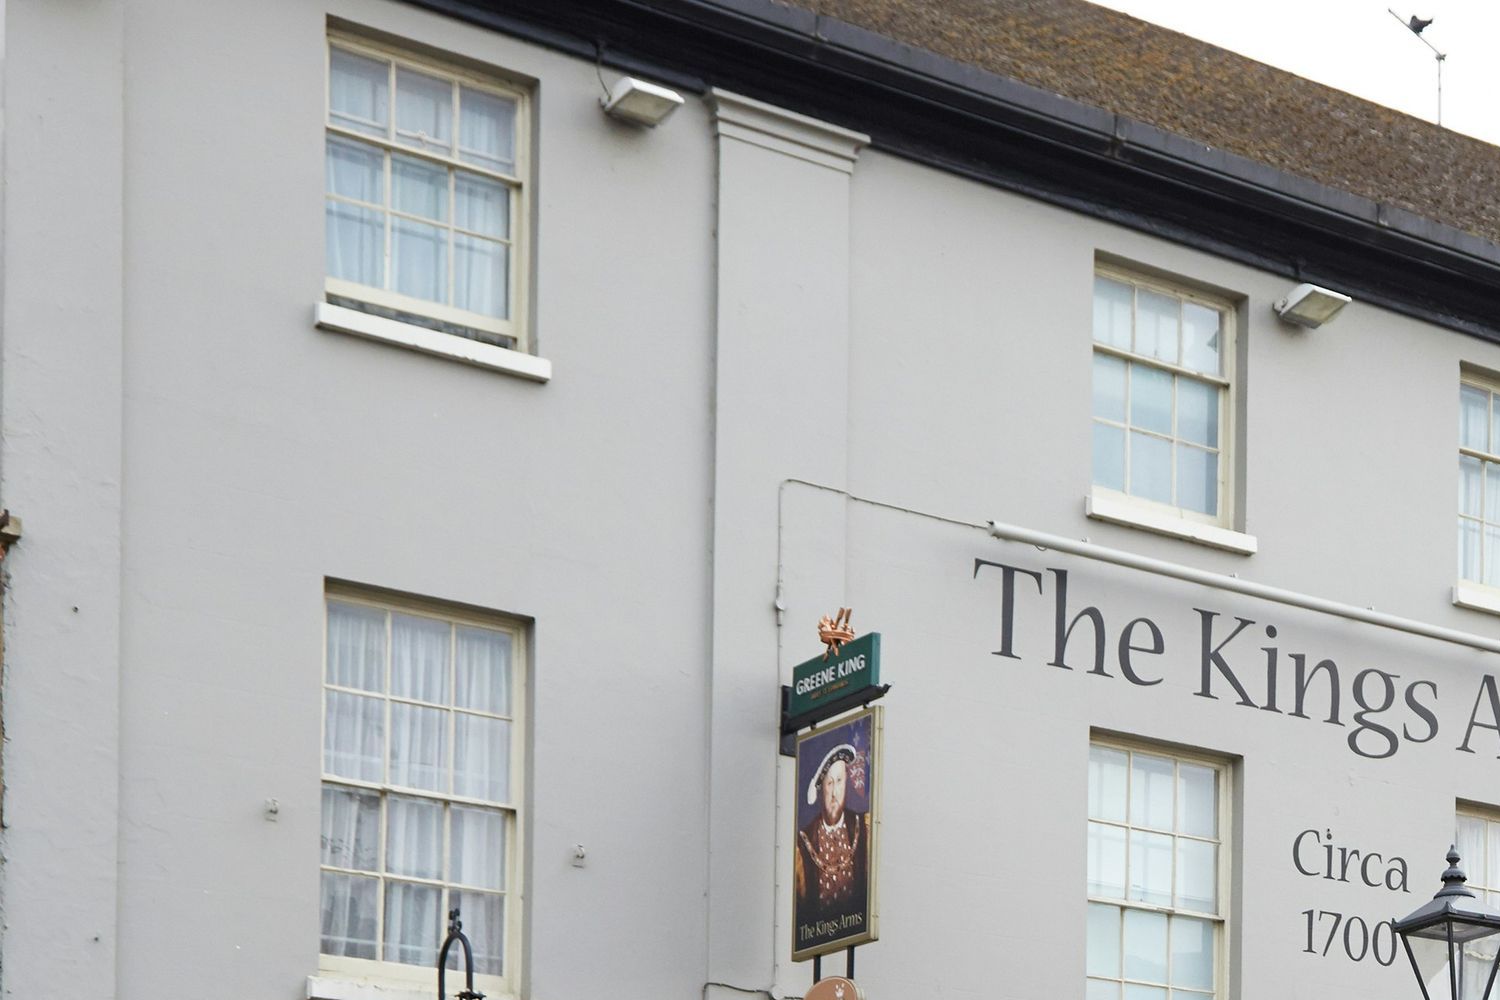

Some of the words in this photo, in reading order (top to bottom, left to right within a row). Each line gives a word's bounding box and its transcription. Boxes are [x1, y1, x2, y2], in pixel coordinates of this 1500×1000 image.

[796, 666, 836, 695] GREENE
[838, 654, 866, 678] KING
[973, 557, 1165, 686] The
[1192, 607, 1440, 760] Kings
[1292, 828, 1411, 894] Circa
[800, 923, 814, 941] The
[815, 917, 839, 937] Kings
[840, 912, 863, 929] Arms
[1301, 908, 1398, 967] 1700
